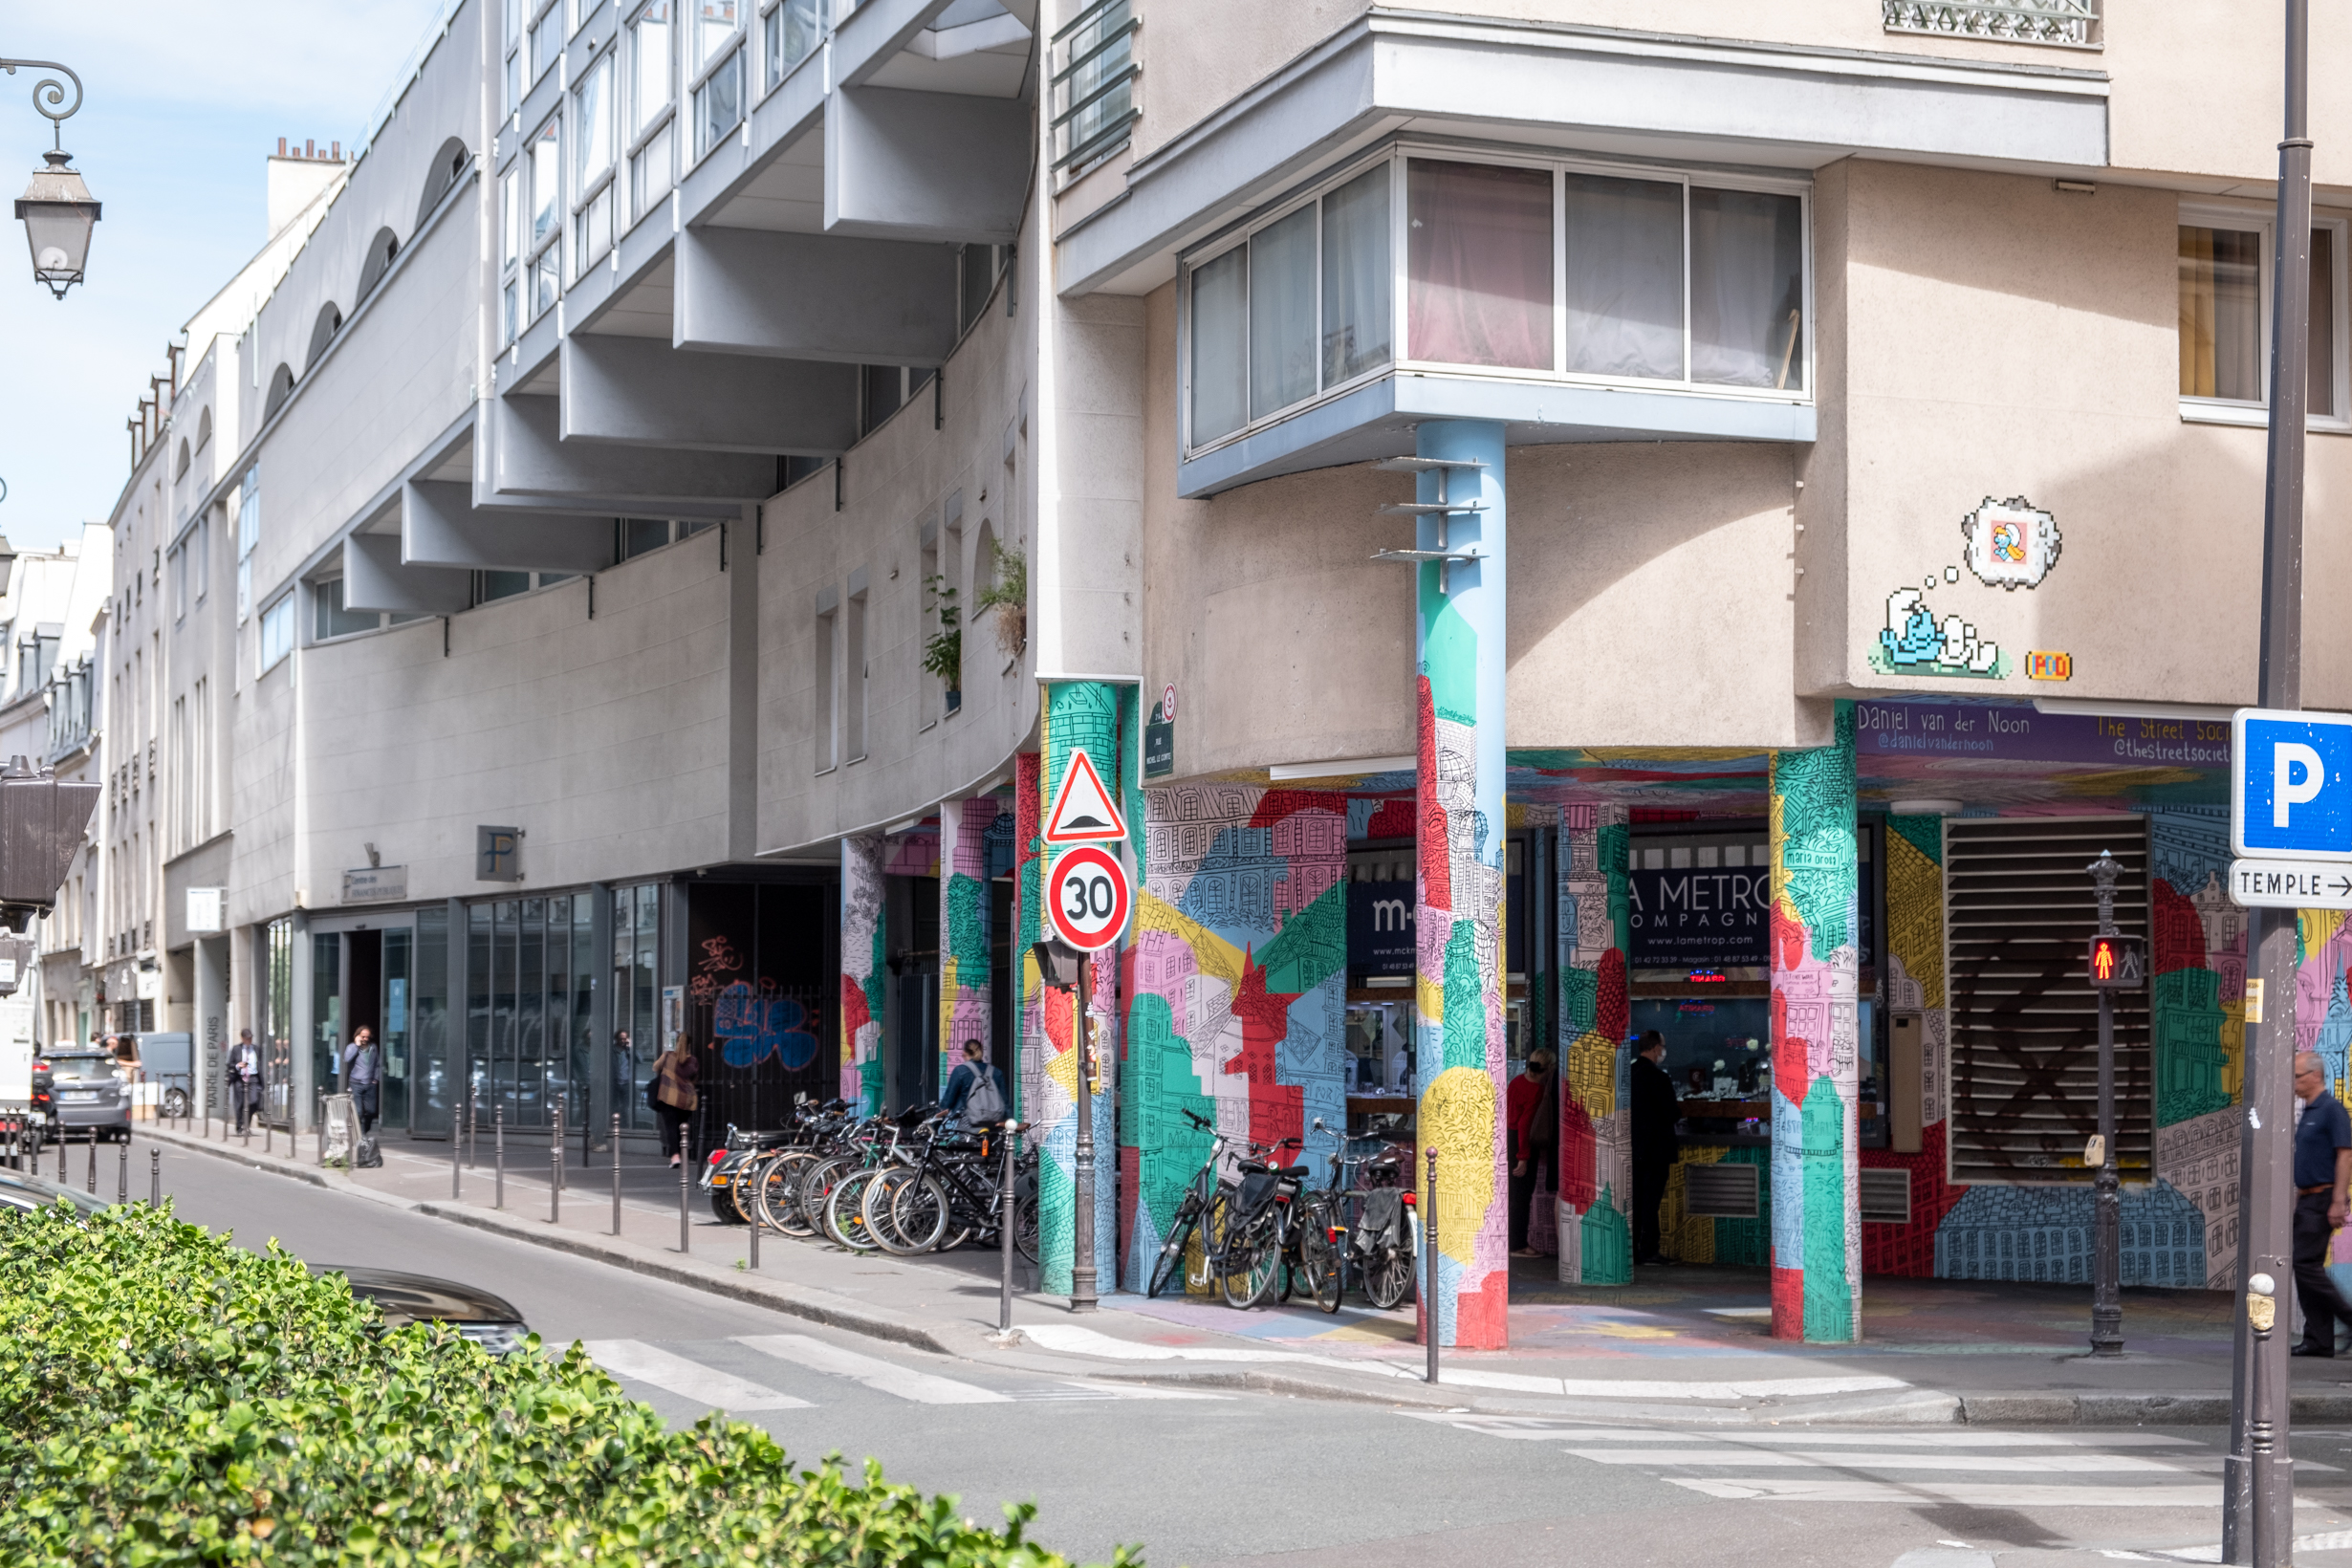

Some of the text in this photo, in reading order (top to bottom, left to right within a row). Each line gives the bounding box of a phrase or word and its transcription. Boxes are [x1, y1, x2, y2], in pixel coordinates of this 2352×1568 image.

[1858, 705, 2030, 733] Daniel van der Noon
[2098, 716, 2232, 741] The Street Soci
[1878, 730, 1993, 751] @danielvandernoon
[2274, 742, 2324, 828] P
[2241, 872, 2320, 896] TEMPLE
[1065, 876, 1113, 920] 30
[1647, 936, 1753, 946] www.lametrop.com
[1683, 956, 1710, 965] Magasin
[207, 1016, 219, 1109] MAIRIE DE PARIS
